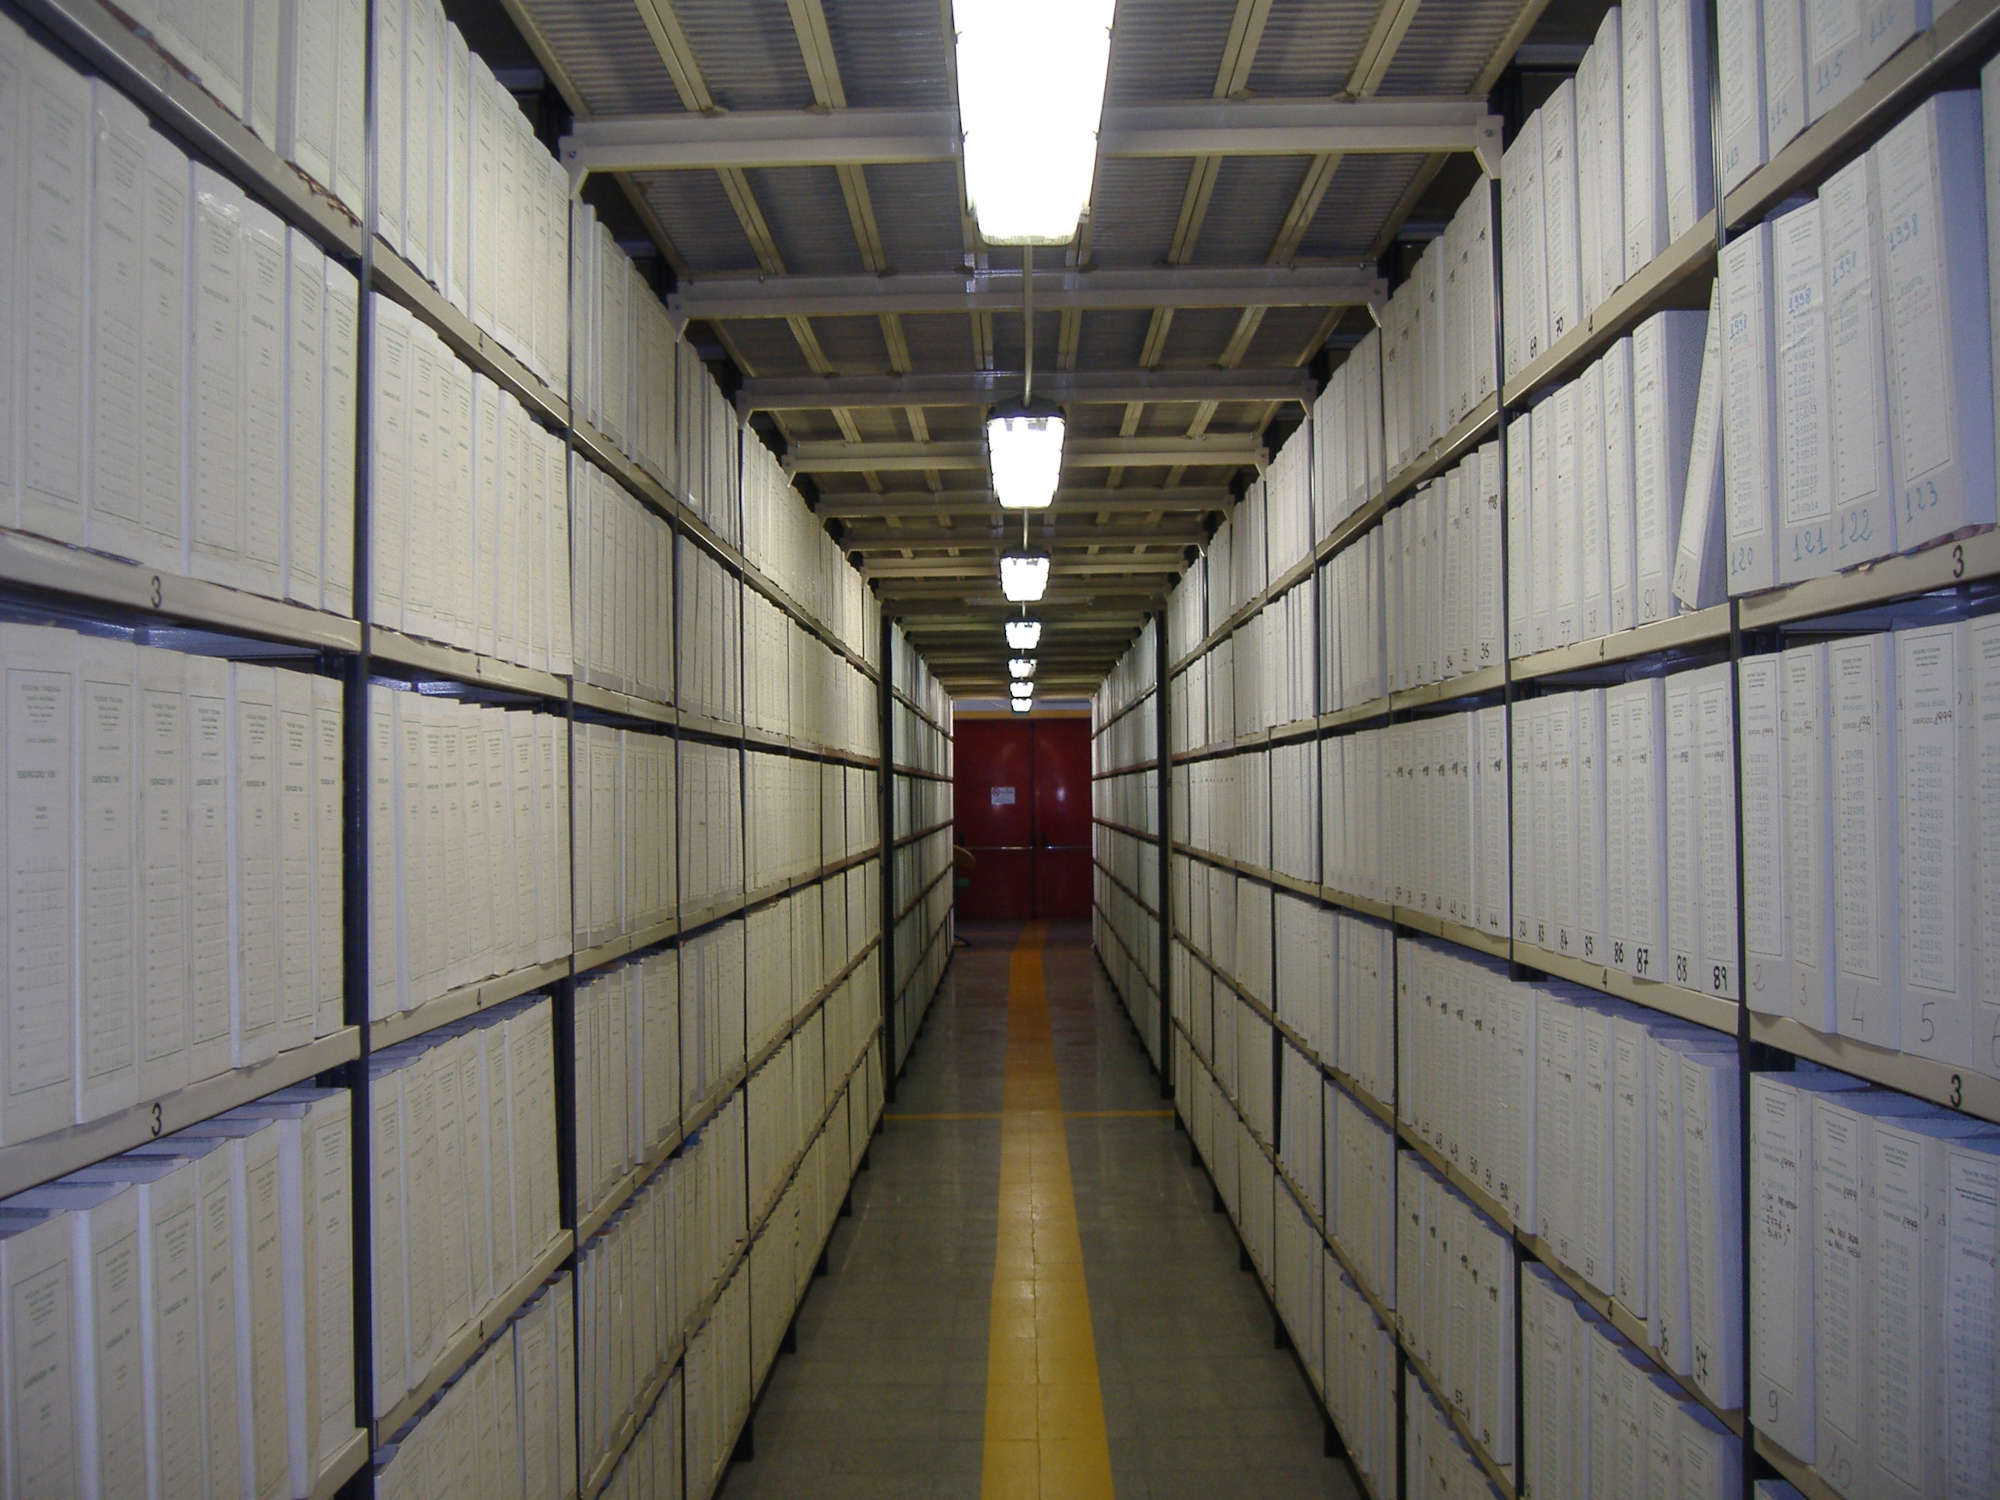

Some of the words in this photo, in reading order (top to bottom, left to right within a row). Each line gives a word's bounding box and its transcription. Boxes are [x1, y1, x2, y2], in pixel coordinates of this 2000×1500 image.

[1905, 480, 1939, 523] 123
[1793, 527, 1829, 562] 121
[1839, 508, 1873, 550] 122
[1952, 545, 1965, 578] 3
[151, 576, 163, 608] 3
[1636, 947, 1649, 975] 87
[1713, 965, 1728, 992] 89
[1919, 1002, 1935, 1042] 5
[1950, 1074, 1963, 1108] 3
[151, 1102, 162, 1136] 3
